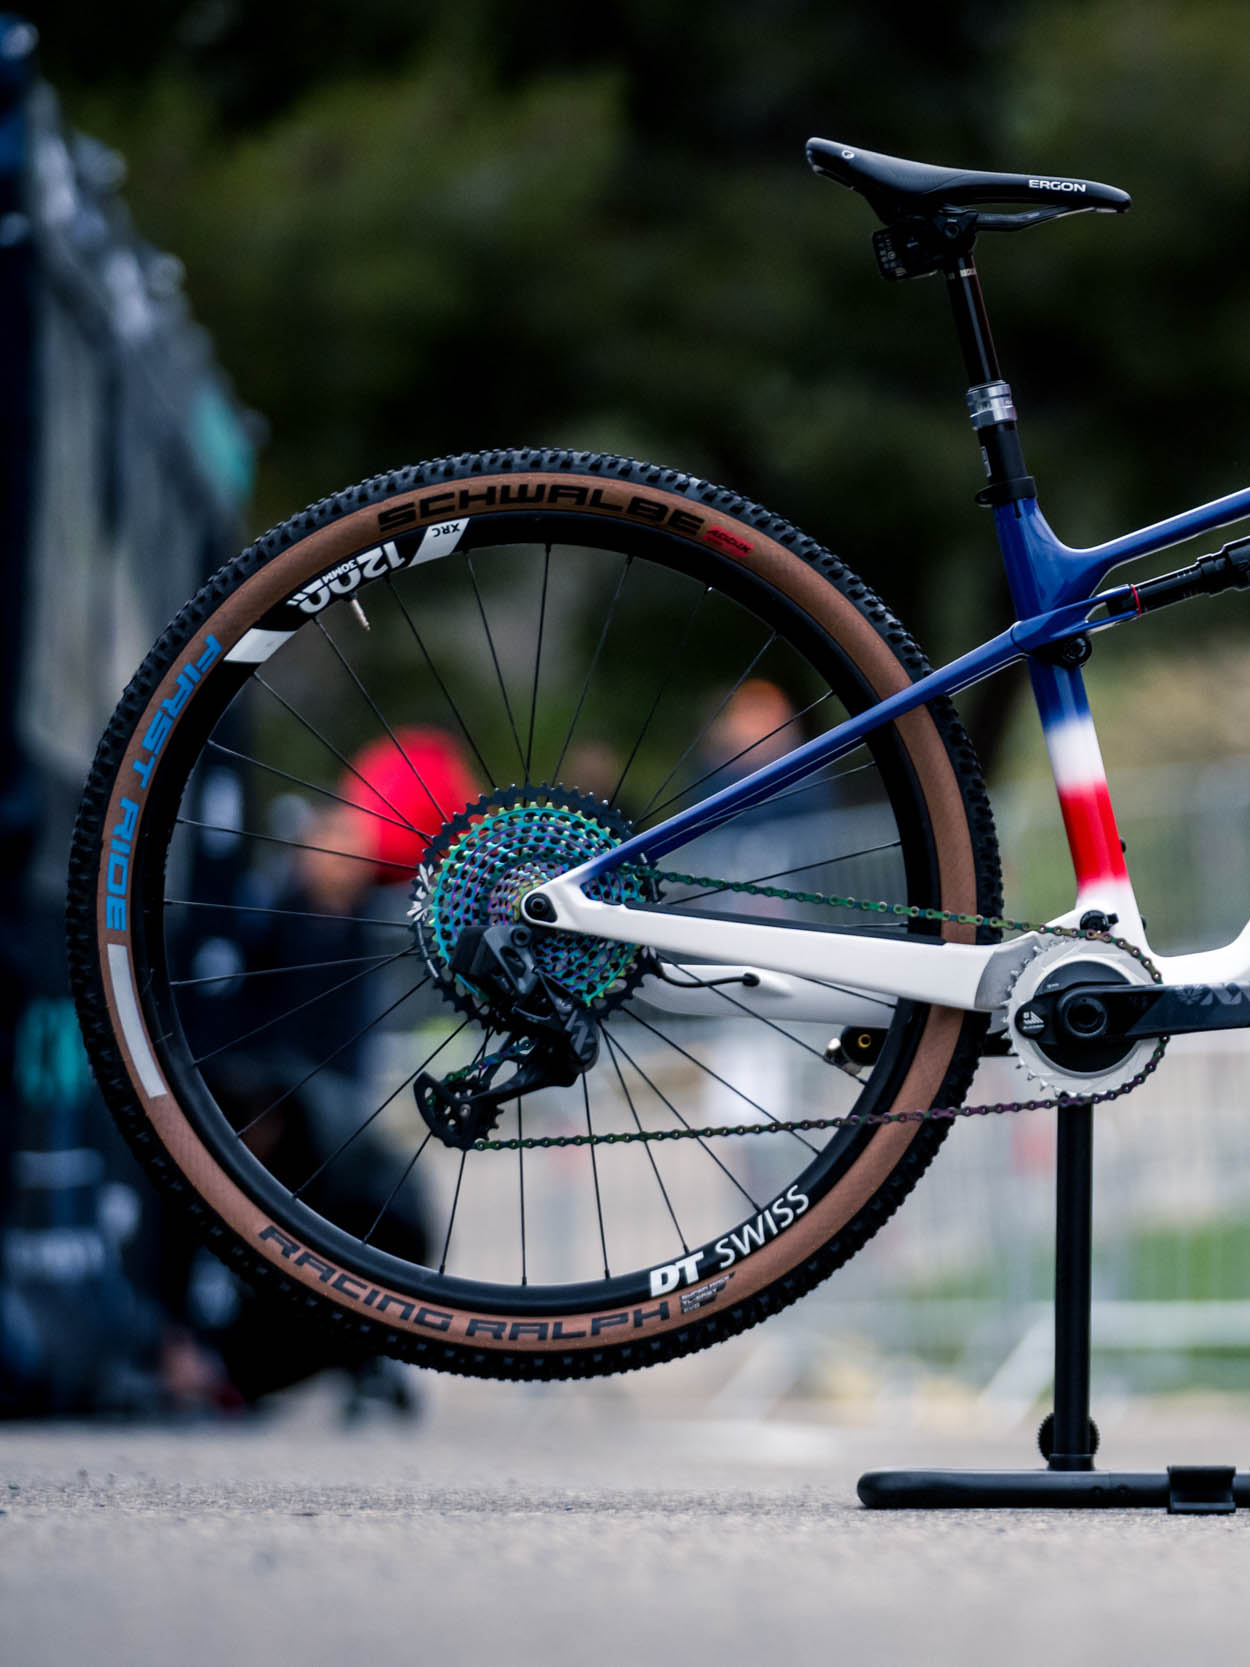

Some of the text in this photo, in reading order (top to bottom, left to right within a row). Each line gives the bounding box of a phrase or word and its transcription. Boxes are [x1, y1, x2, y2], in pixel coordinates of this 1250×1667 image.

[1028, 179, 1087, 193] ERGON
[377, 483, 705, 533] SCHWALBE
[431, 522, 461, 537] XRC
[286, 541, 406, 614] 1200
[322, 559, 357, 583] 30MM
[105, 634, 223, 932] FIRST RIDE
[649, 1183, 810, 1297] DT SWISS
[259, 1224, 671, 1341] RACING RALPH
